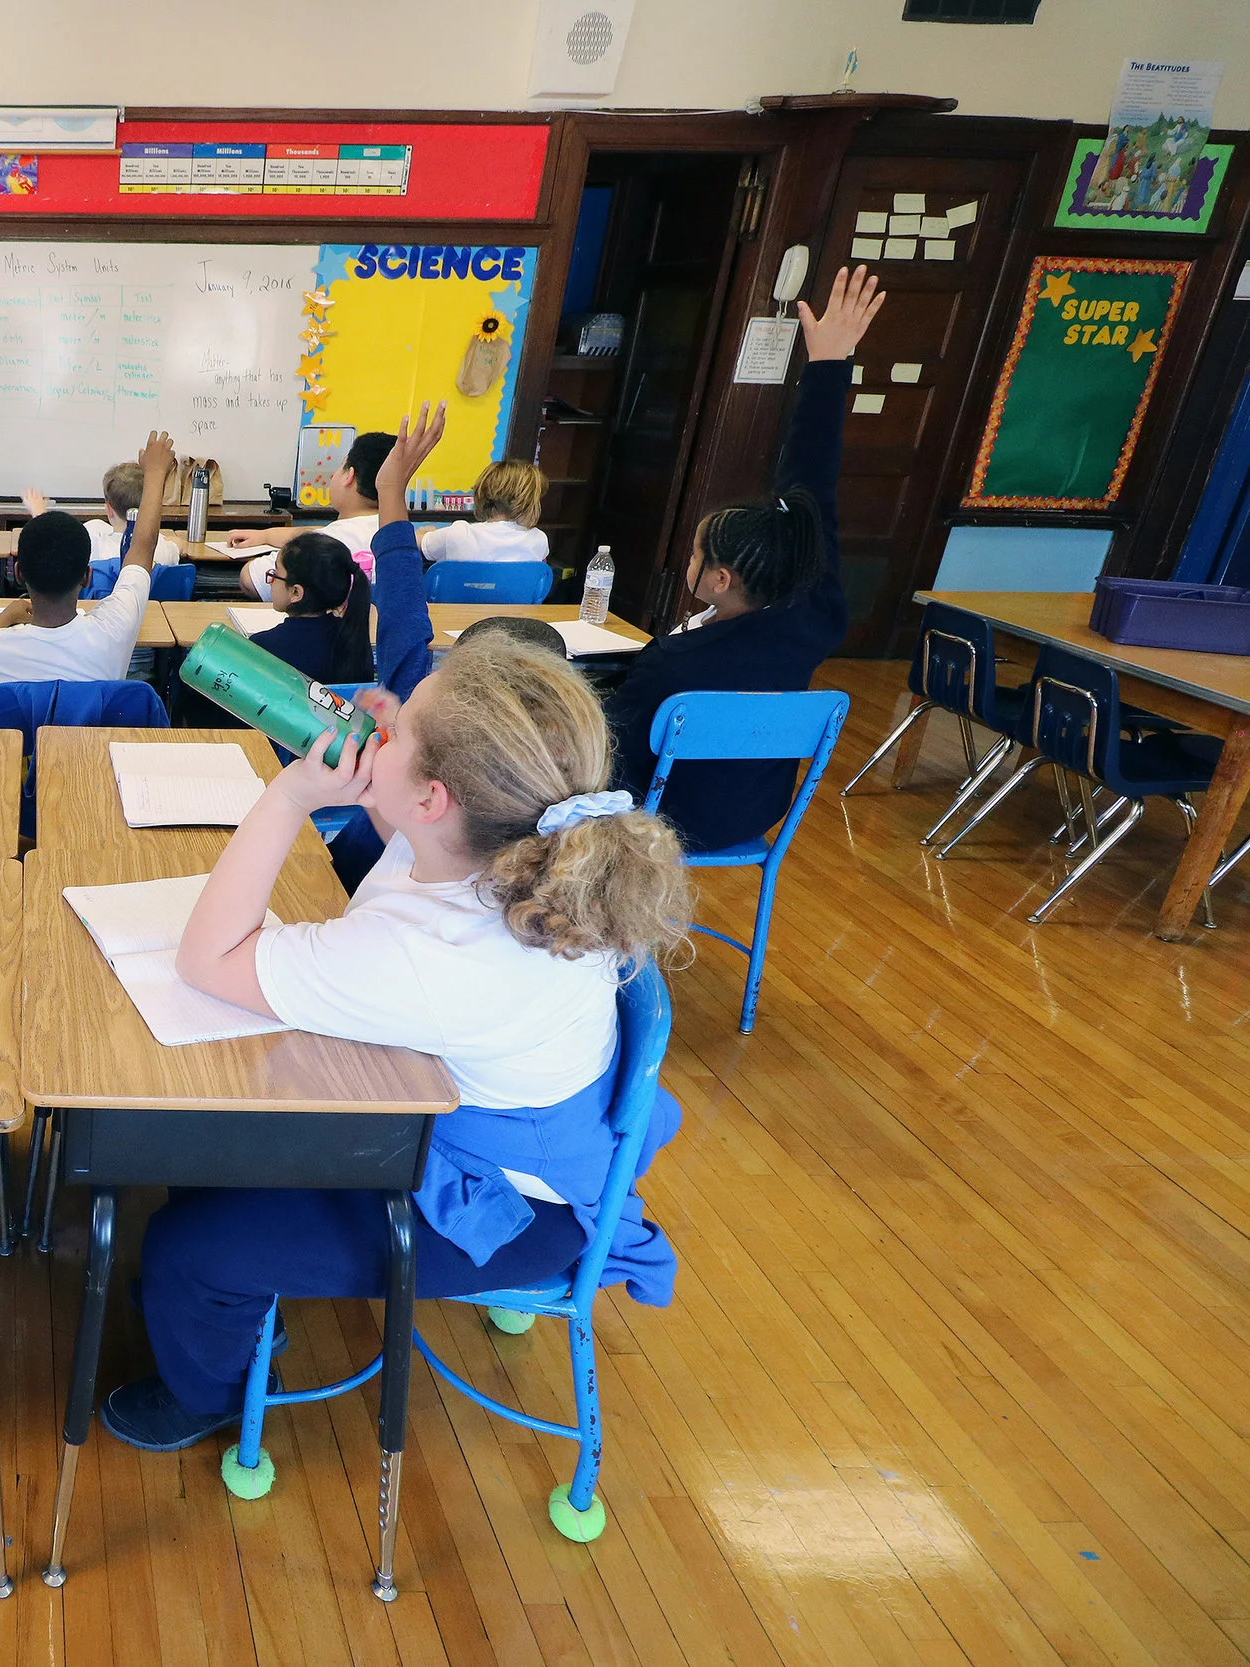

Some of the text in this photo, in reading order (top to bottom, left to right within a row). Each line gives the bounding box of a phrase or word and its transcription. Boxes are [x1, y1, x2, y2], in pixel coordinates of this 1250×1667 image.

[1130, 61, 1190, 73] THE BEATITUDES
[144, 147, 169, 155] Billions
[216, 147, 243, 155] Millions
[285, 148, 320, 156] Thousands
[47, 251, 78, 278] System
[93, 257, 119, 274] Units
[354, 243, 526, 281] SCIENCE
[195, 259, 234, 298] January
[1061, 299, 1140, 322] SUPER
[1063, 323, 1129, 345] STAR
[242, 368, 261, 382] that
[269, 369, 282, 382] has
[192, 392, 288, 412] mass and takes up
[318, 428, 342, 447] IN
[300, 486, 331, 507] OU
